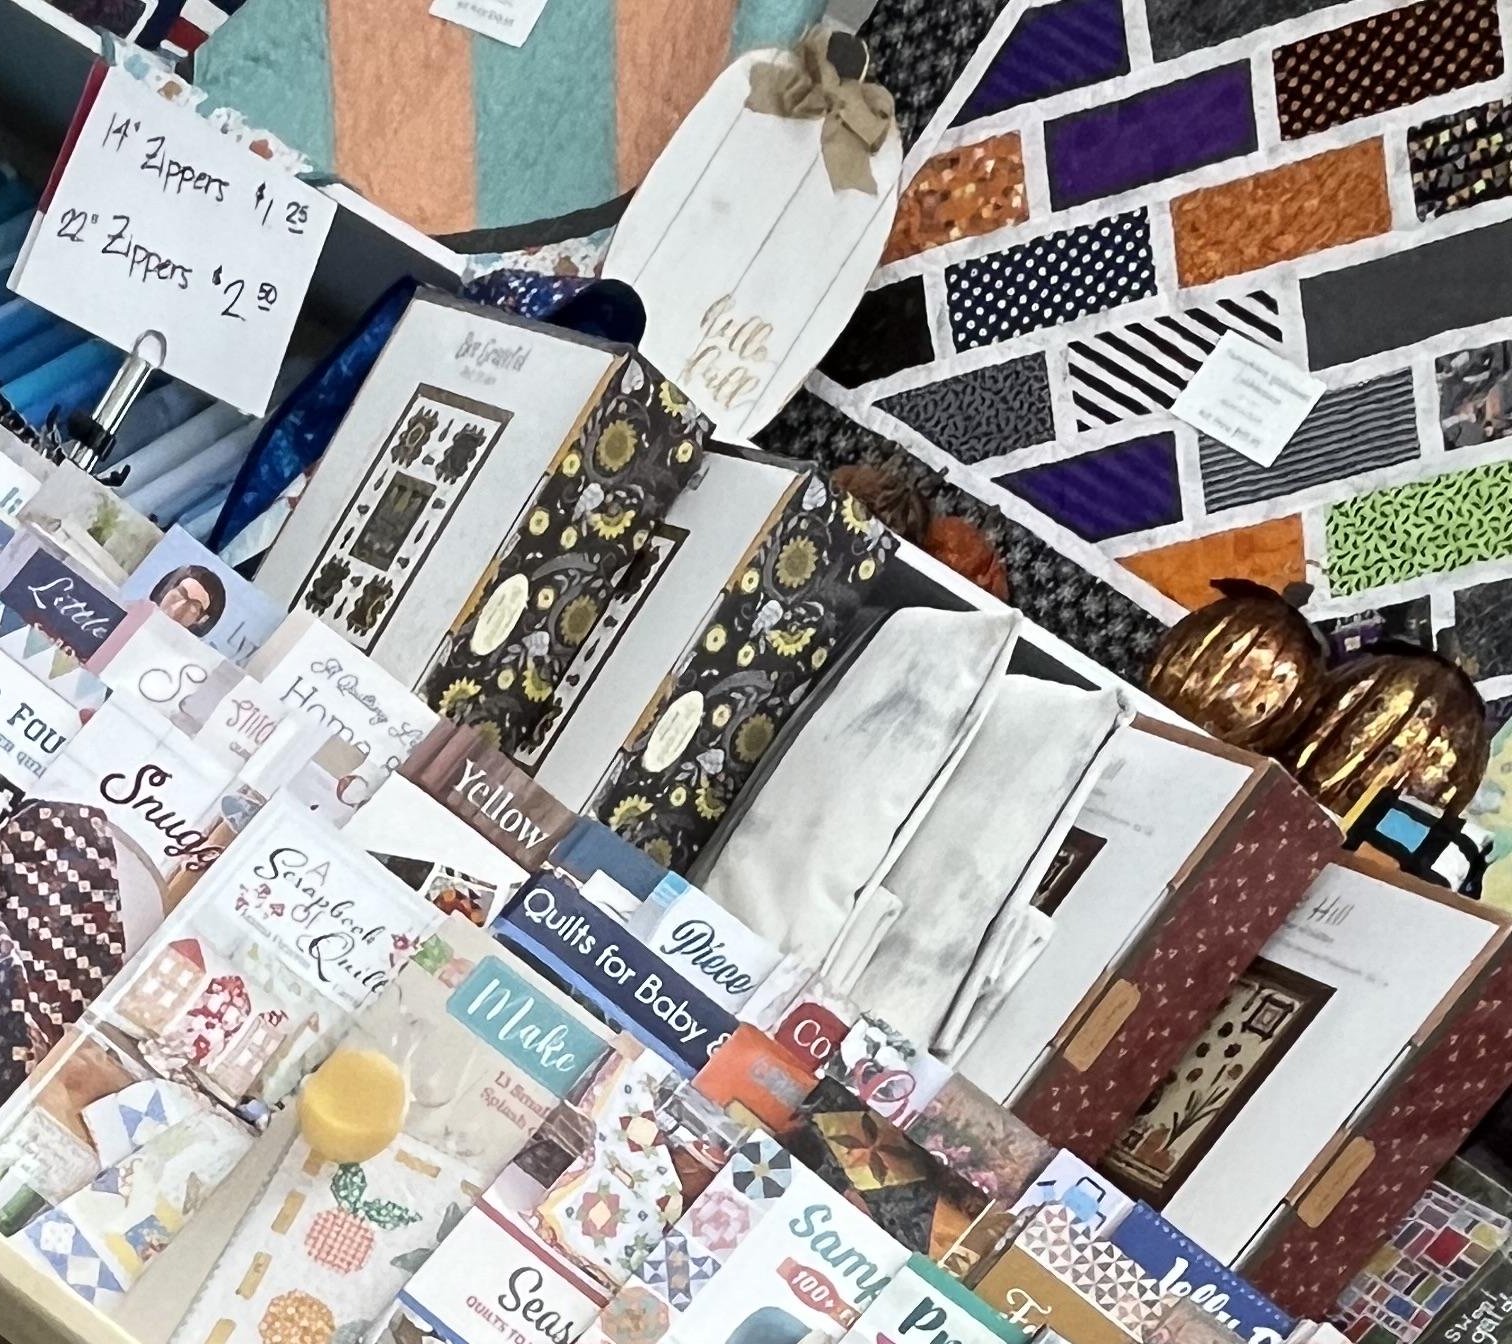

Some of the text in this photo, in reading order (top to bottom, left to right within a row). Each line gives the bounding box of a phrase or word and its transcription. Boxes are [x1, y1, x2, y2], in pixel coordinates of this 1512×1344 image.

[141, 136, 230, 202] Zippers
[102, 216, 192, 290] Zippers
[454, 758, 550, 850] Yellow
[523, 888, 595, 955] Quilts
[595, 944, 636, 985] for
[635, 974, 707, 1043] Baby
[661, 920, 753, 994] Piece
[468, 978, 575, 1071] Make
[466, 1295, 509, 1333] QUILTS
